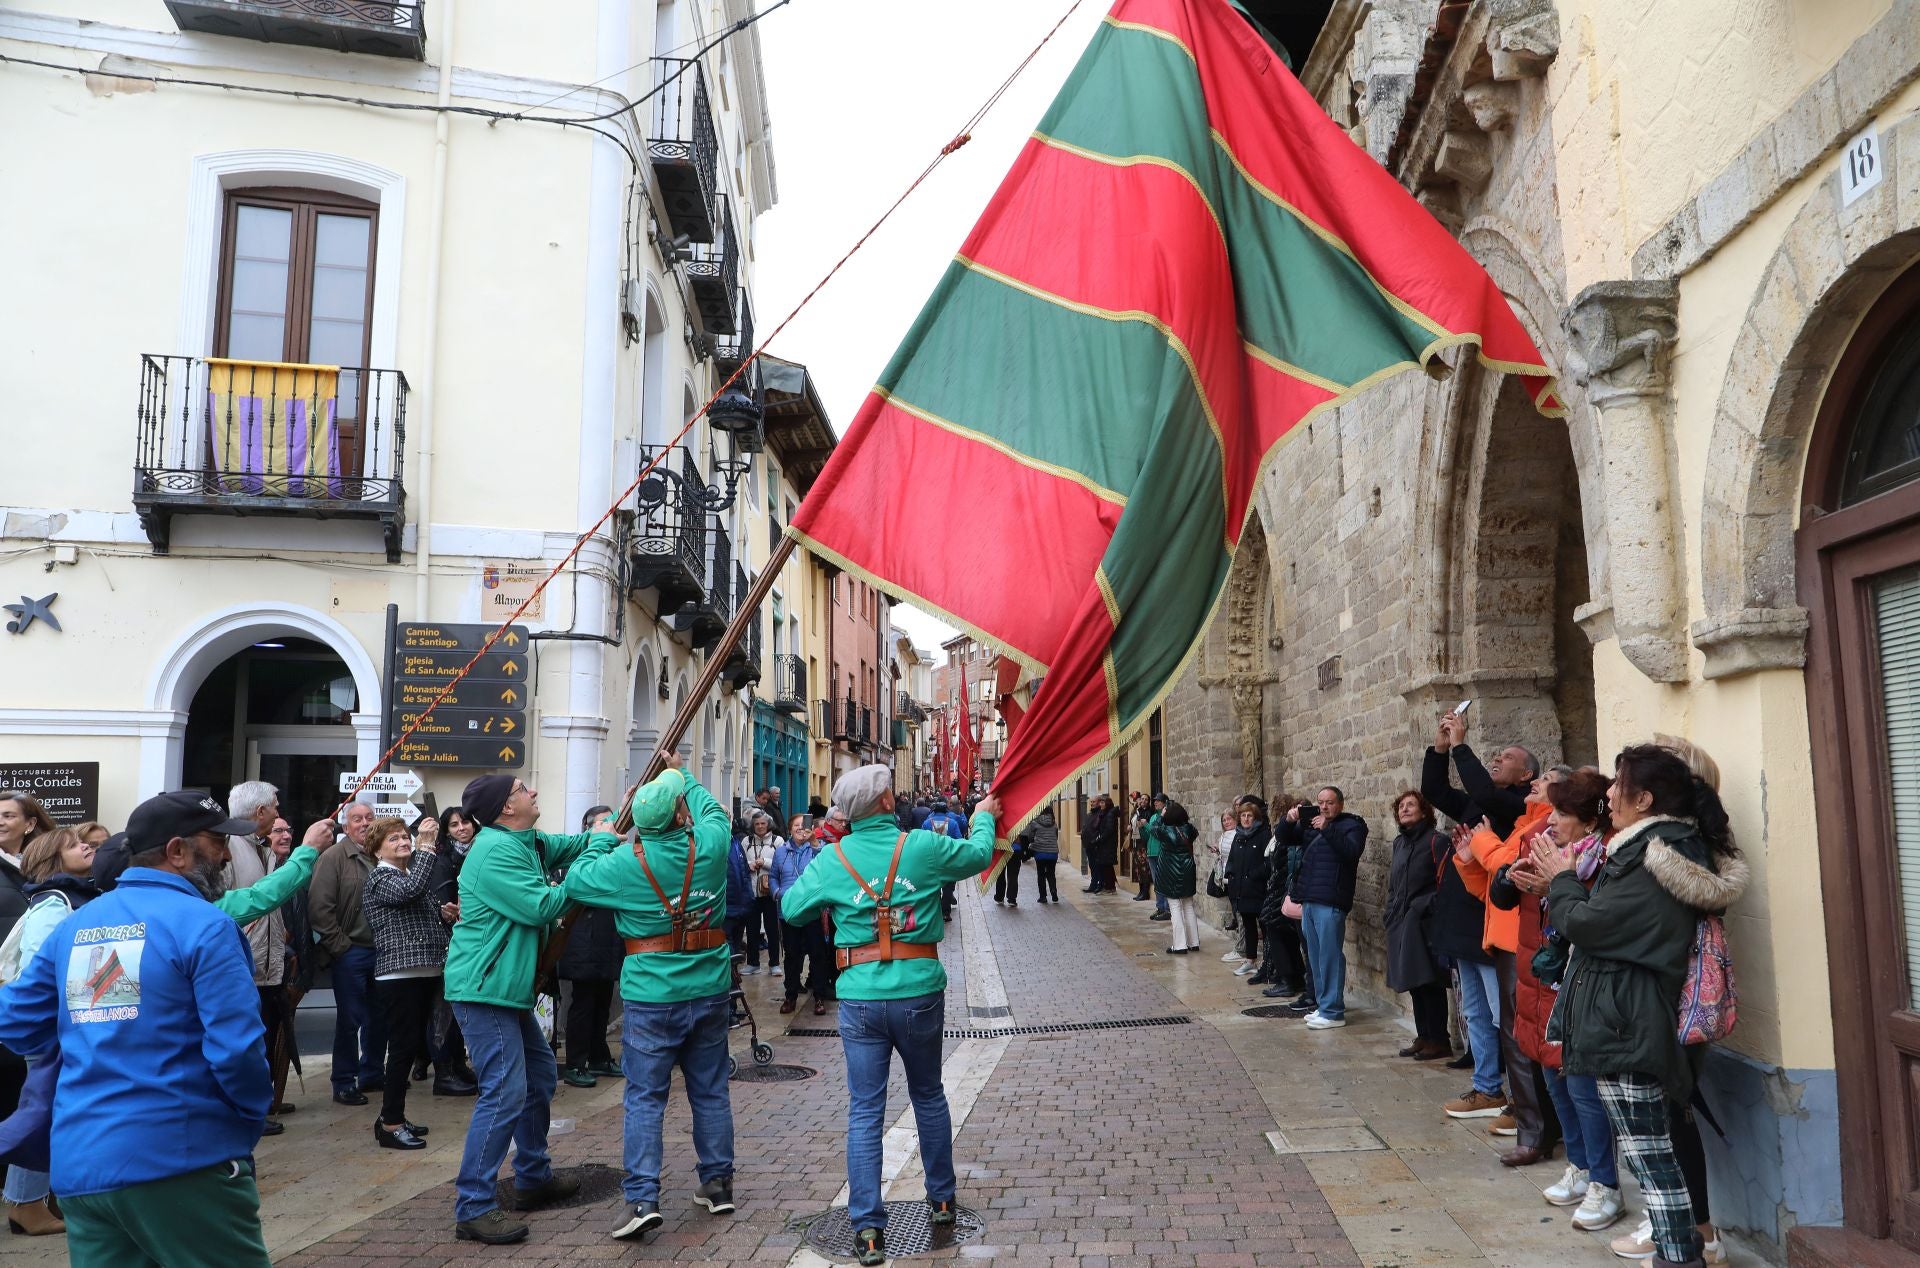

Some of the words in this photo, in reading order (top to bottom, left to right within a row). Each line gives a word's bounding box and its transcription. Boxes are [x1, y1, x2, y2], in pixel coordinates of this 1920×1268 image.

[1847, 137, 1874, 190] 18
[494, 593, 528, 607] Mayor
[406, 627, 440, 637] Camino
[419, 638, 458, 648] Santiago
[405, 656, 433, 667] Iglesia
[418, 667, 434, 675] San
[436, 666, 465, 676] André
[403, 694, 414, 703] de
[416, 695, 433, 703] San
[401, 723, 413, 732] de
[415, 724, 451, 733] Turismo
[401, 743, 430, 752] Iglesia
[400, 752, 412, 760] de
[432, 753, 459, 762] Julián
[0, 777, 10, 788] e
[12, 776, 31, 787] los
[34, 776, 82, 787] Condes
[35, 796, 82, 809] ograma
[74, 922, 146, 945] PENDONEROS
